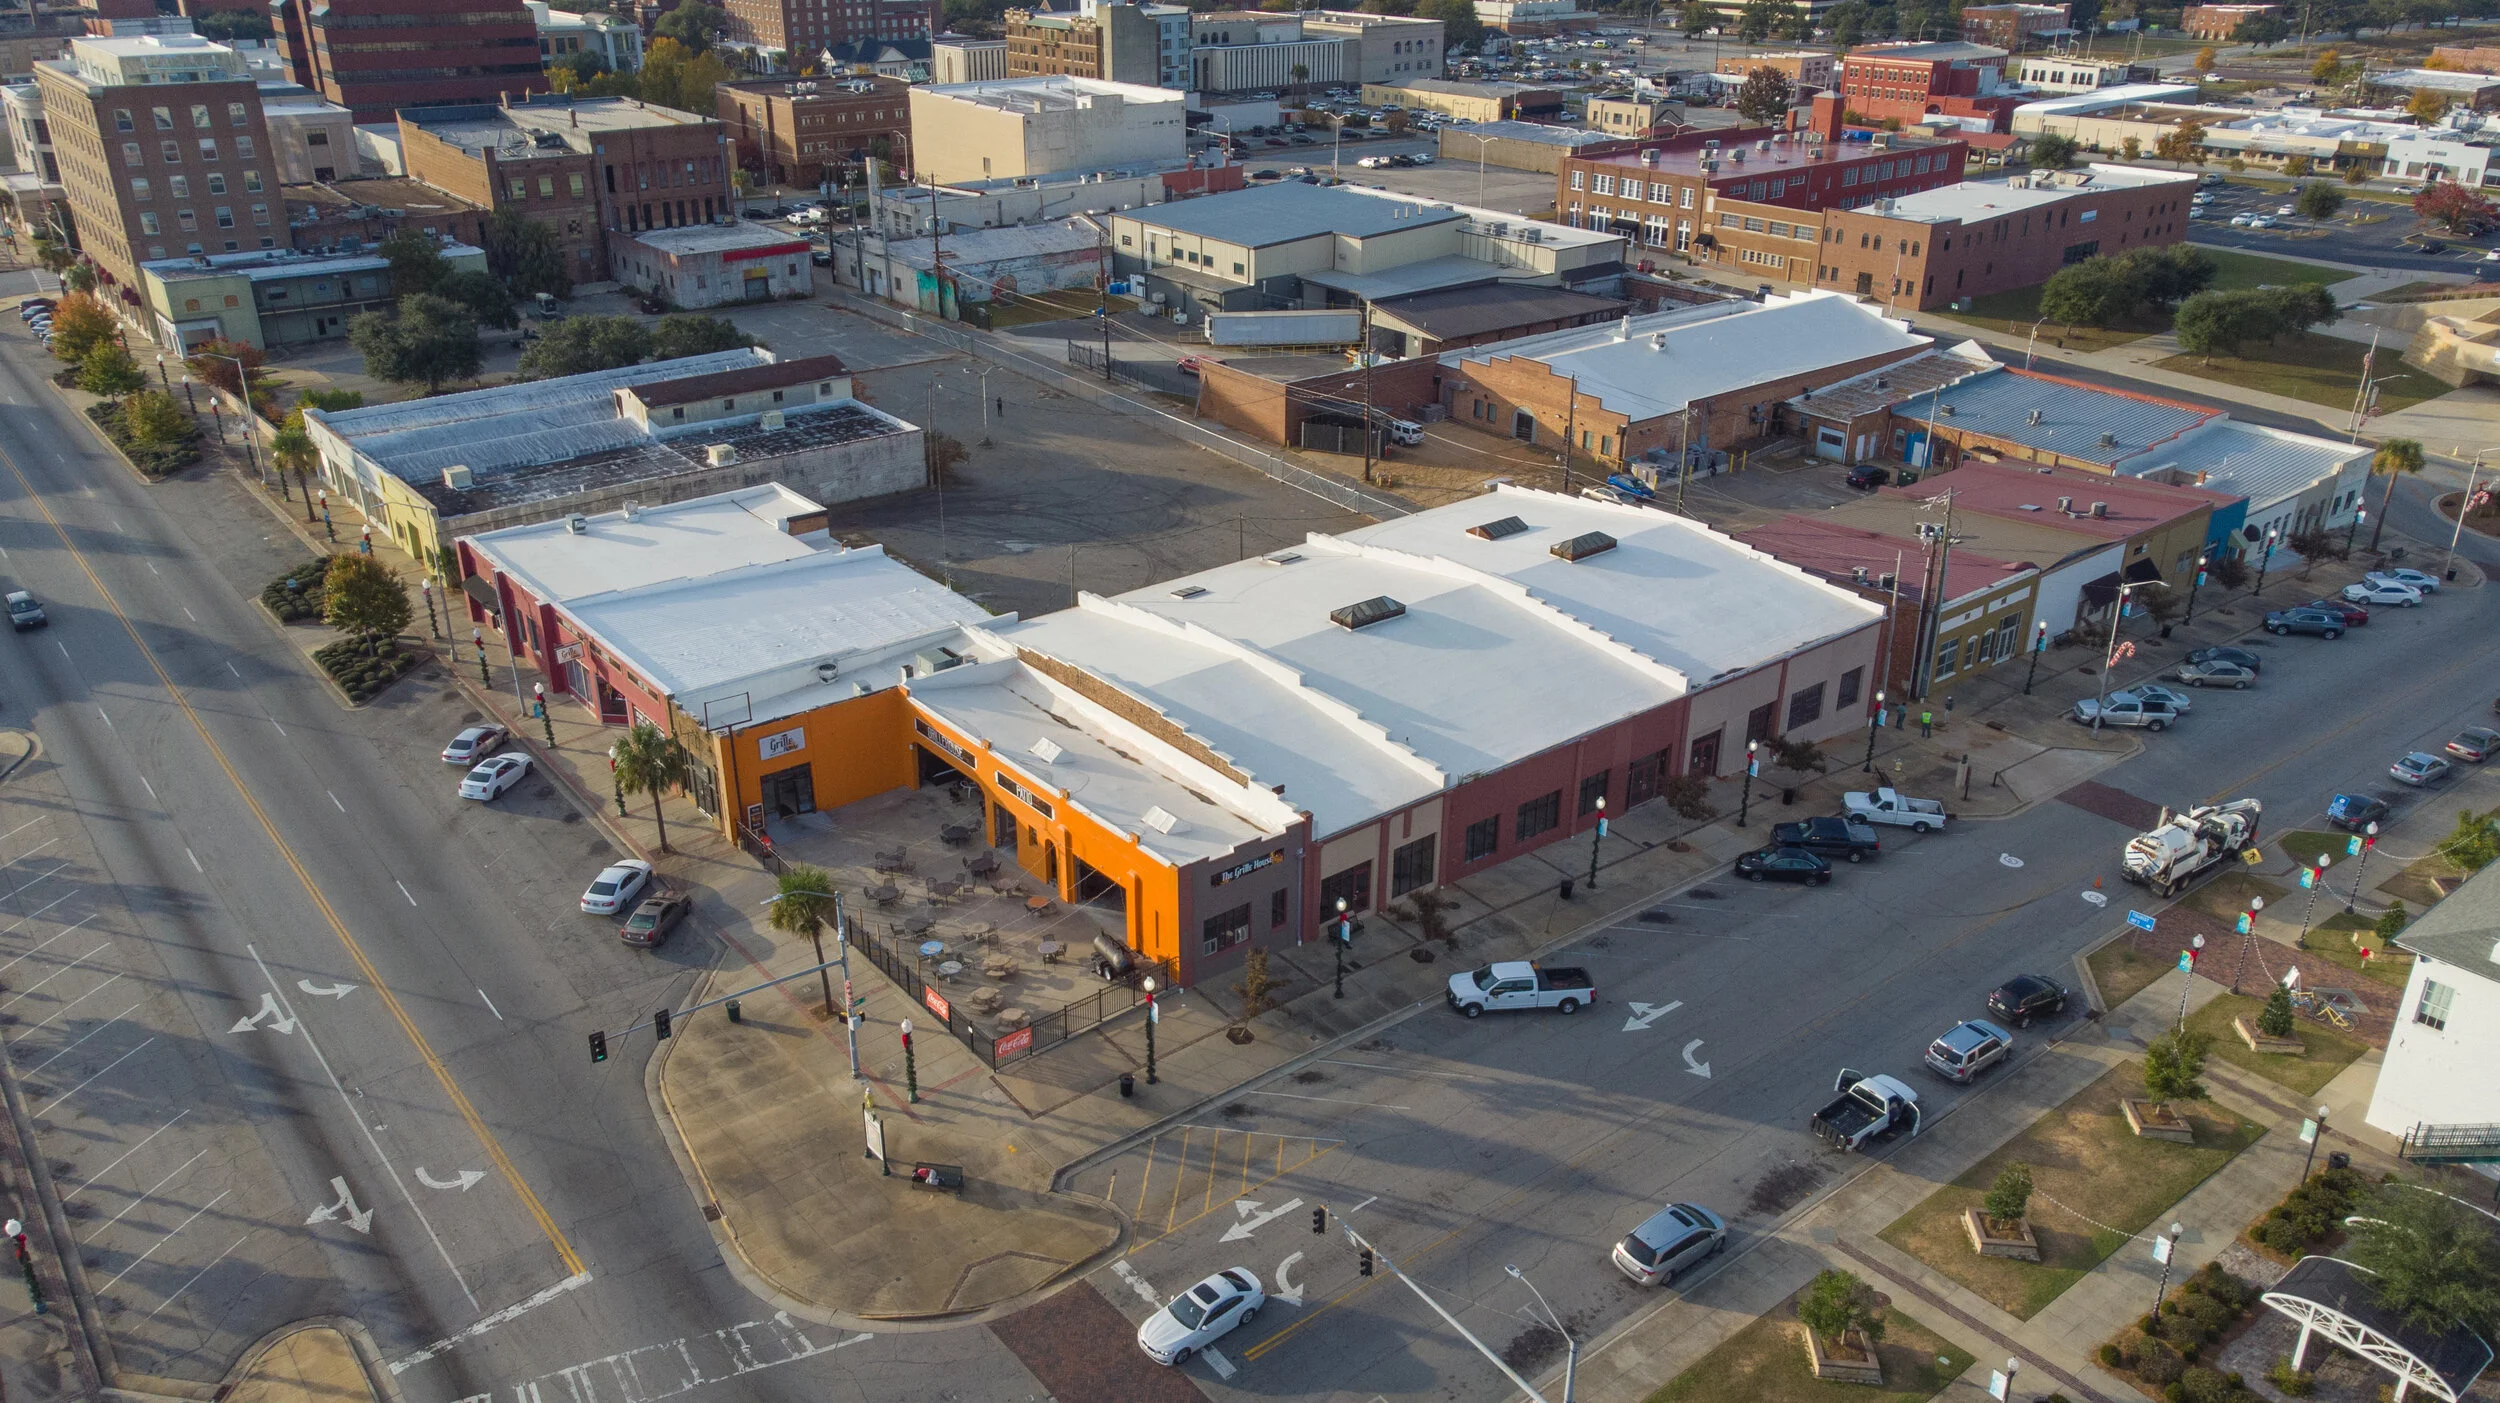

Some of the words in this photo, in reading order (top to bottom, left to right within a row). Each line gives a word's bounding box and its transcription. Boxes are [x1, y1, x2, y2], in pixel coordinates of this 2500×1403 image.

[770, 734, 793, 752] Grille
[1016, 784, 1033, 806] PATIO
[1222, 871, 1233, 882] The
[1234, 863, 1253, 879] Grille
[1253, 857, 1273, 870] House
